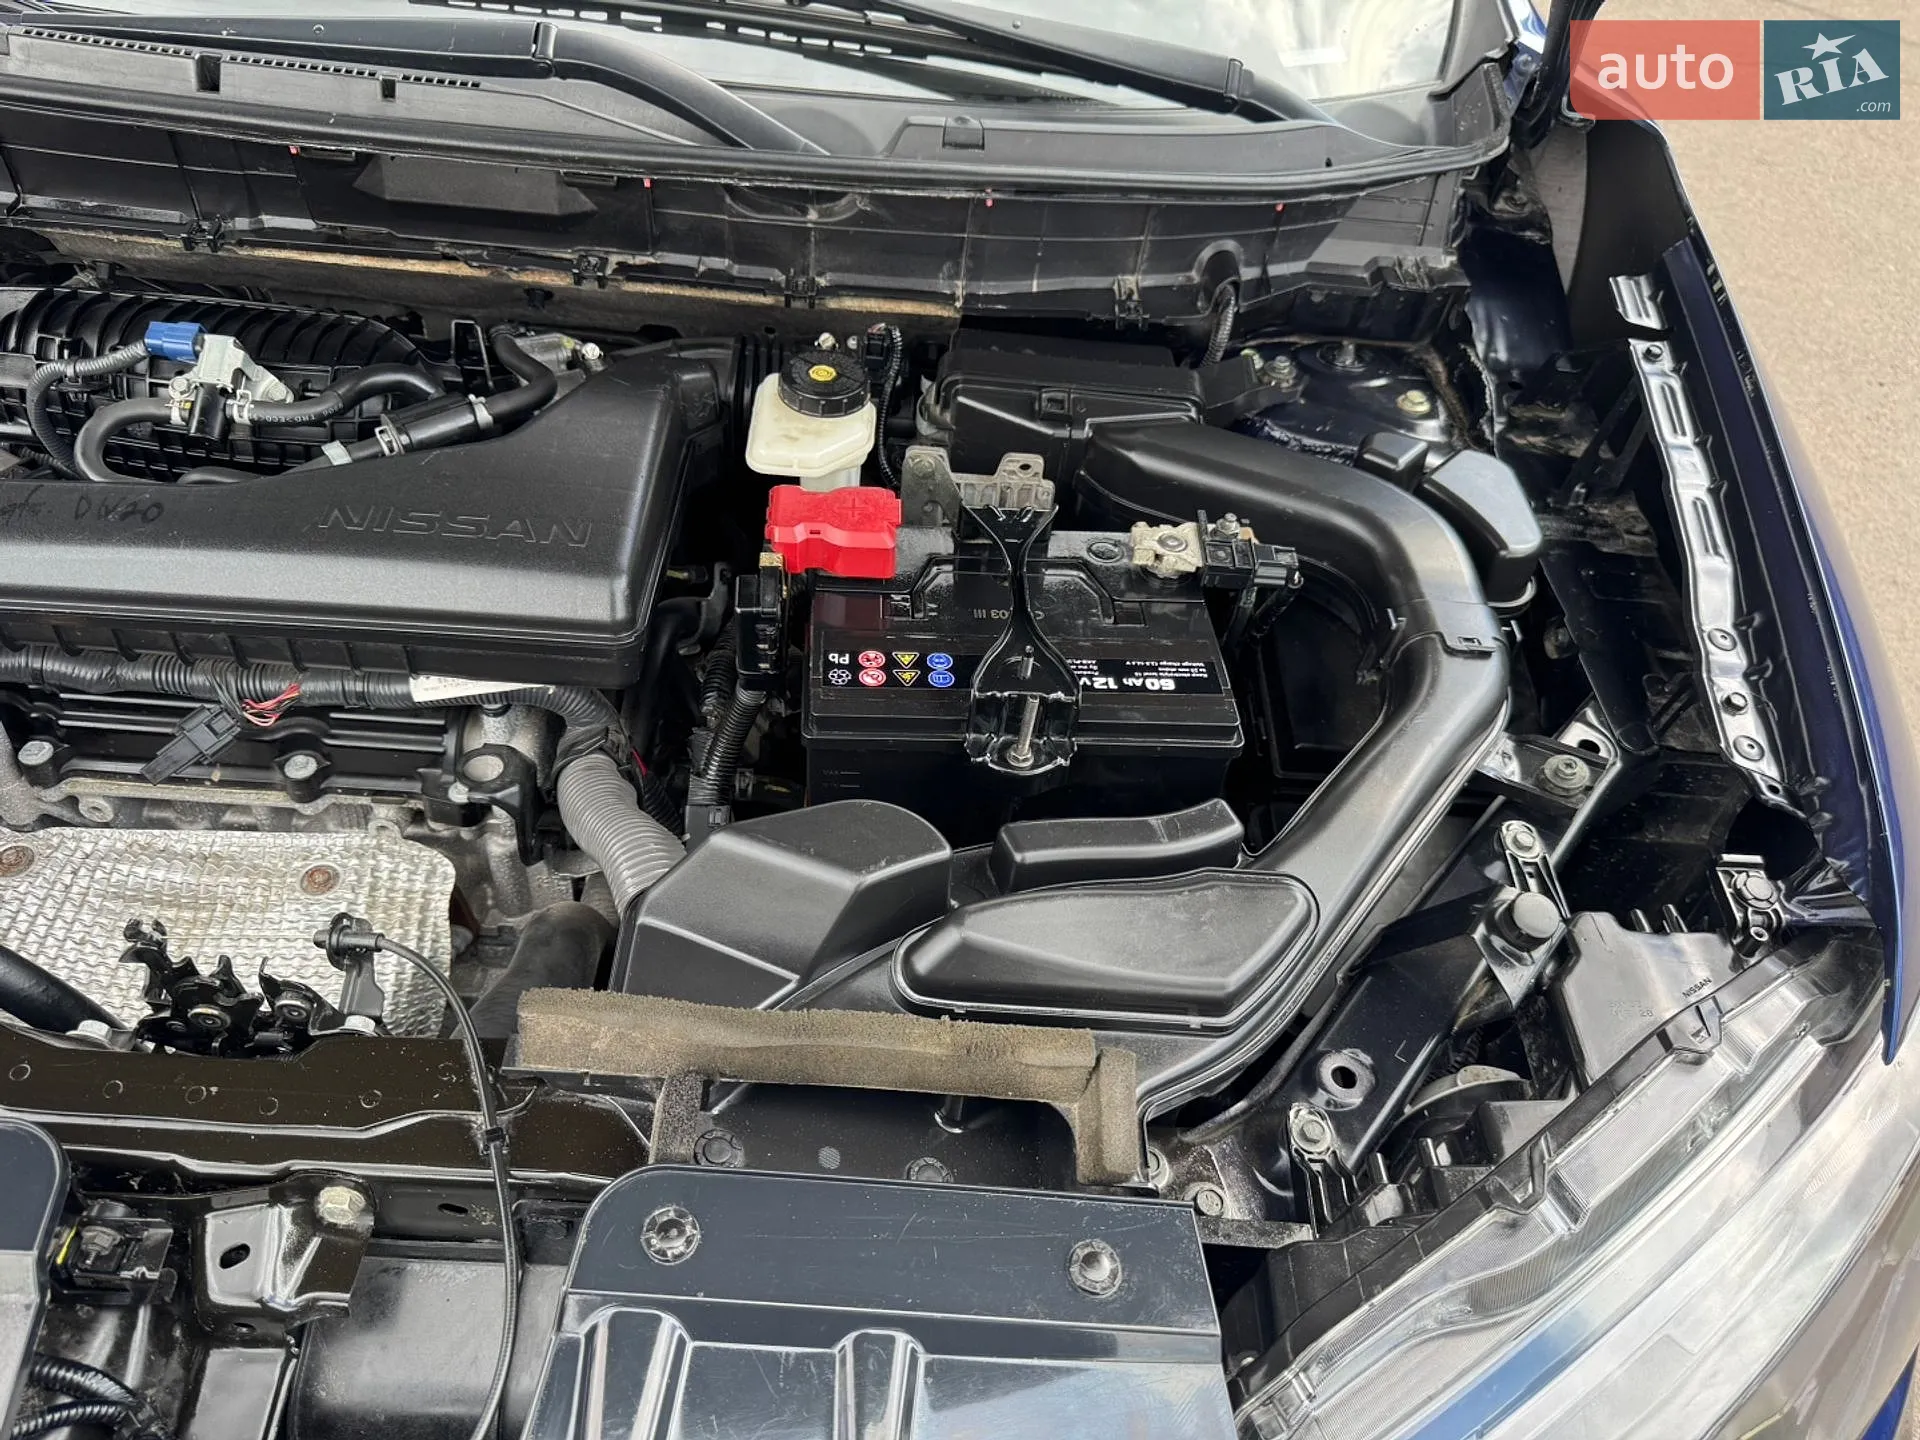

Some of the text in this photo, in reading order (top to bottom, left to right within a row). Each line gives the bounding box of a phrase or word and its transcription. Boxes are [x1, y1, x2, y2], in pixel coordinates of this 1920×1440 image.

[318, 505, 594, 548] NISSAN
[828, 652, 850, 665] Pb
[1122, 677, 1176, 691] 60Ah
[1681, 976, 1714, 999] NISSAN
